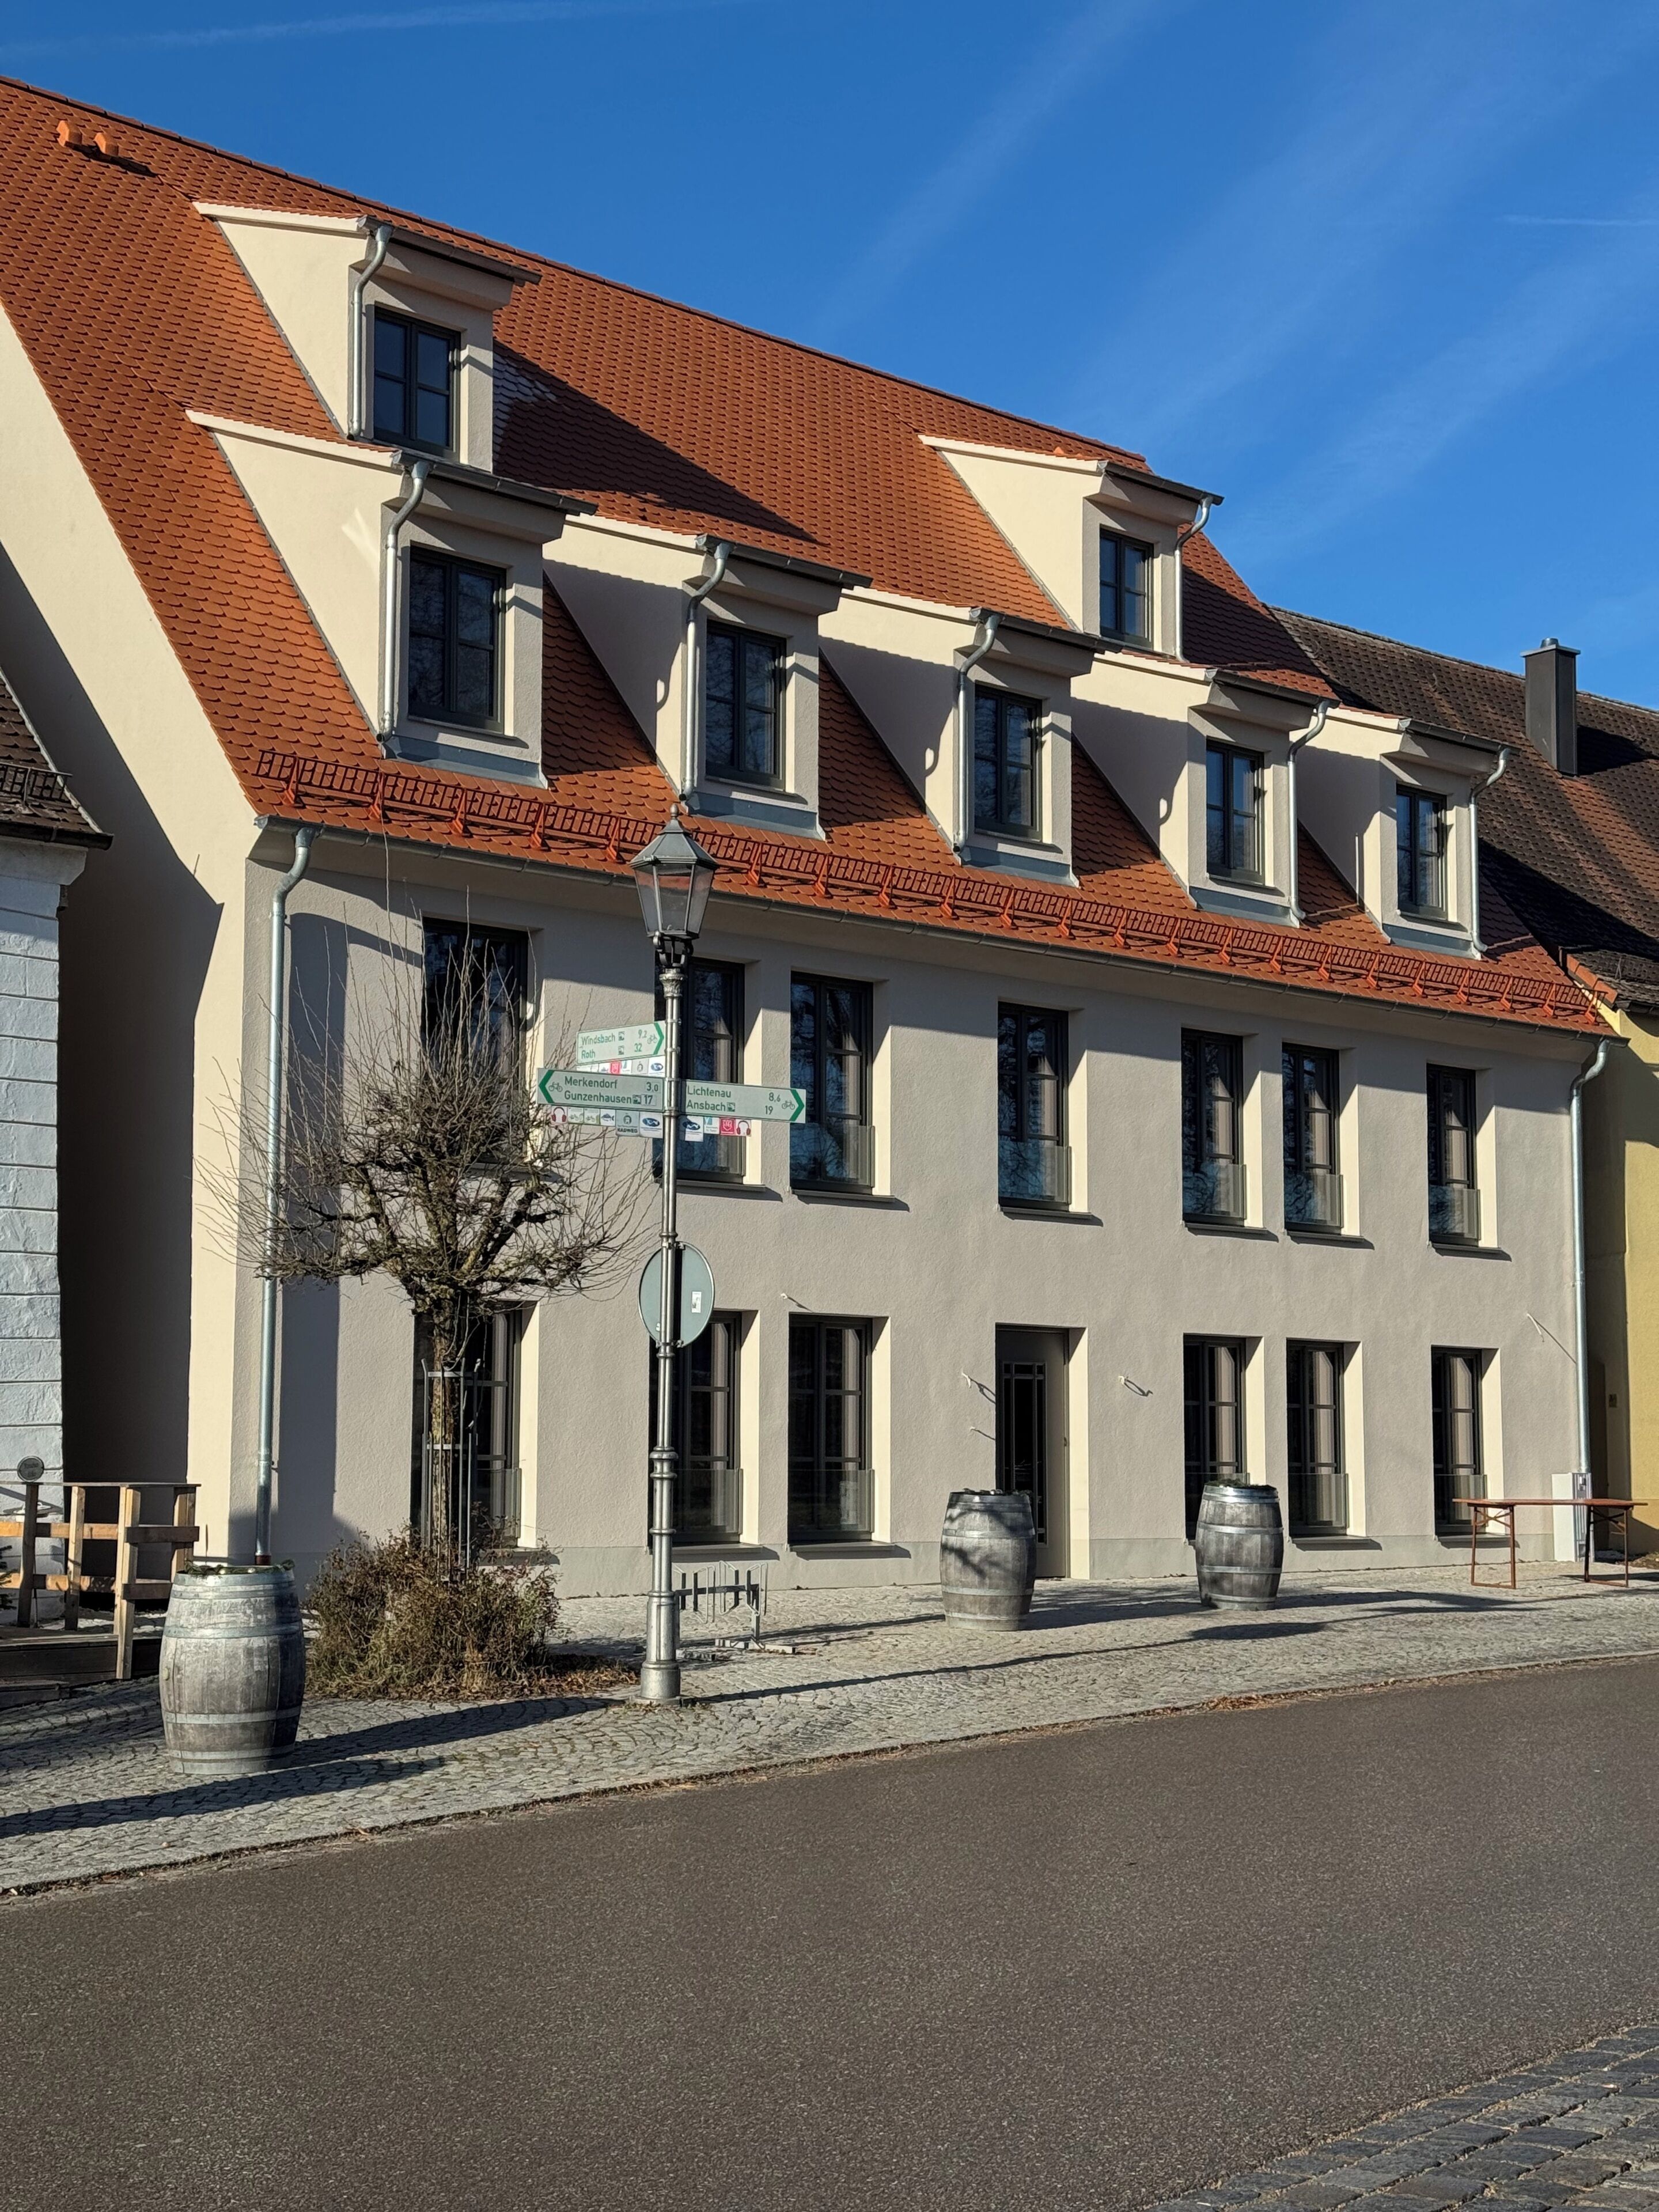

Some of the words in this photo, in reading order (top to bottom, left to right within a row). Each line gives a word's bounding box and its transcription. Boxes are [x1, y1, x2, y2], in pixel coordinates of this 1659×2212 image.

[581, 1033, 615, 1045] Windsbach
[581, 1049, 596, 1059] Roth
[634, 1043, 642, 1052] 32
[565, 1076, 618, 1089] Merkendorf
[646, 1082, 659, 1092] 3,0
[564, 1090, 632, 1104] Gunzenhausen
[644, 1095, 653, 1105] 17
[687, 1085, 732, 1098] Lichtenau
[768, 1092, 781, 1103] 8,6
[687, 1100, 726, 1112] Ansbach
[765, 1105, 774, 1115] 19
